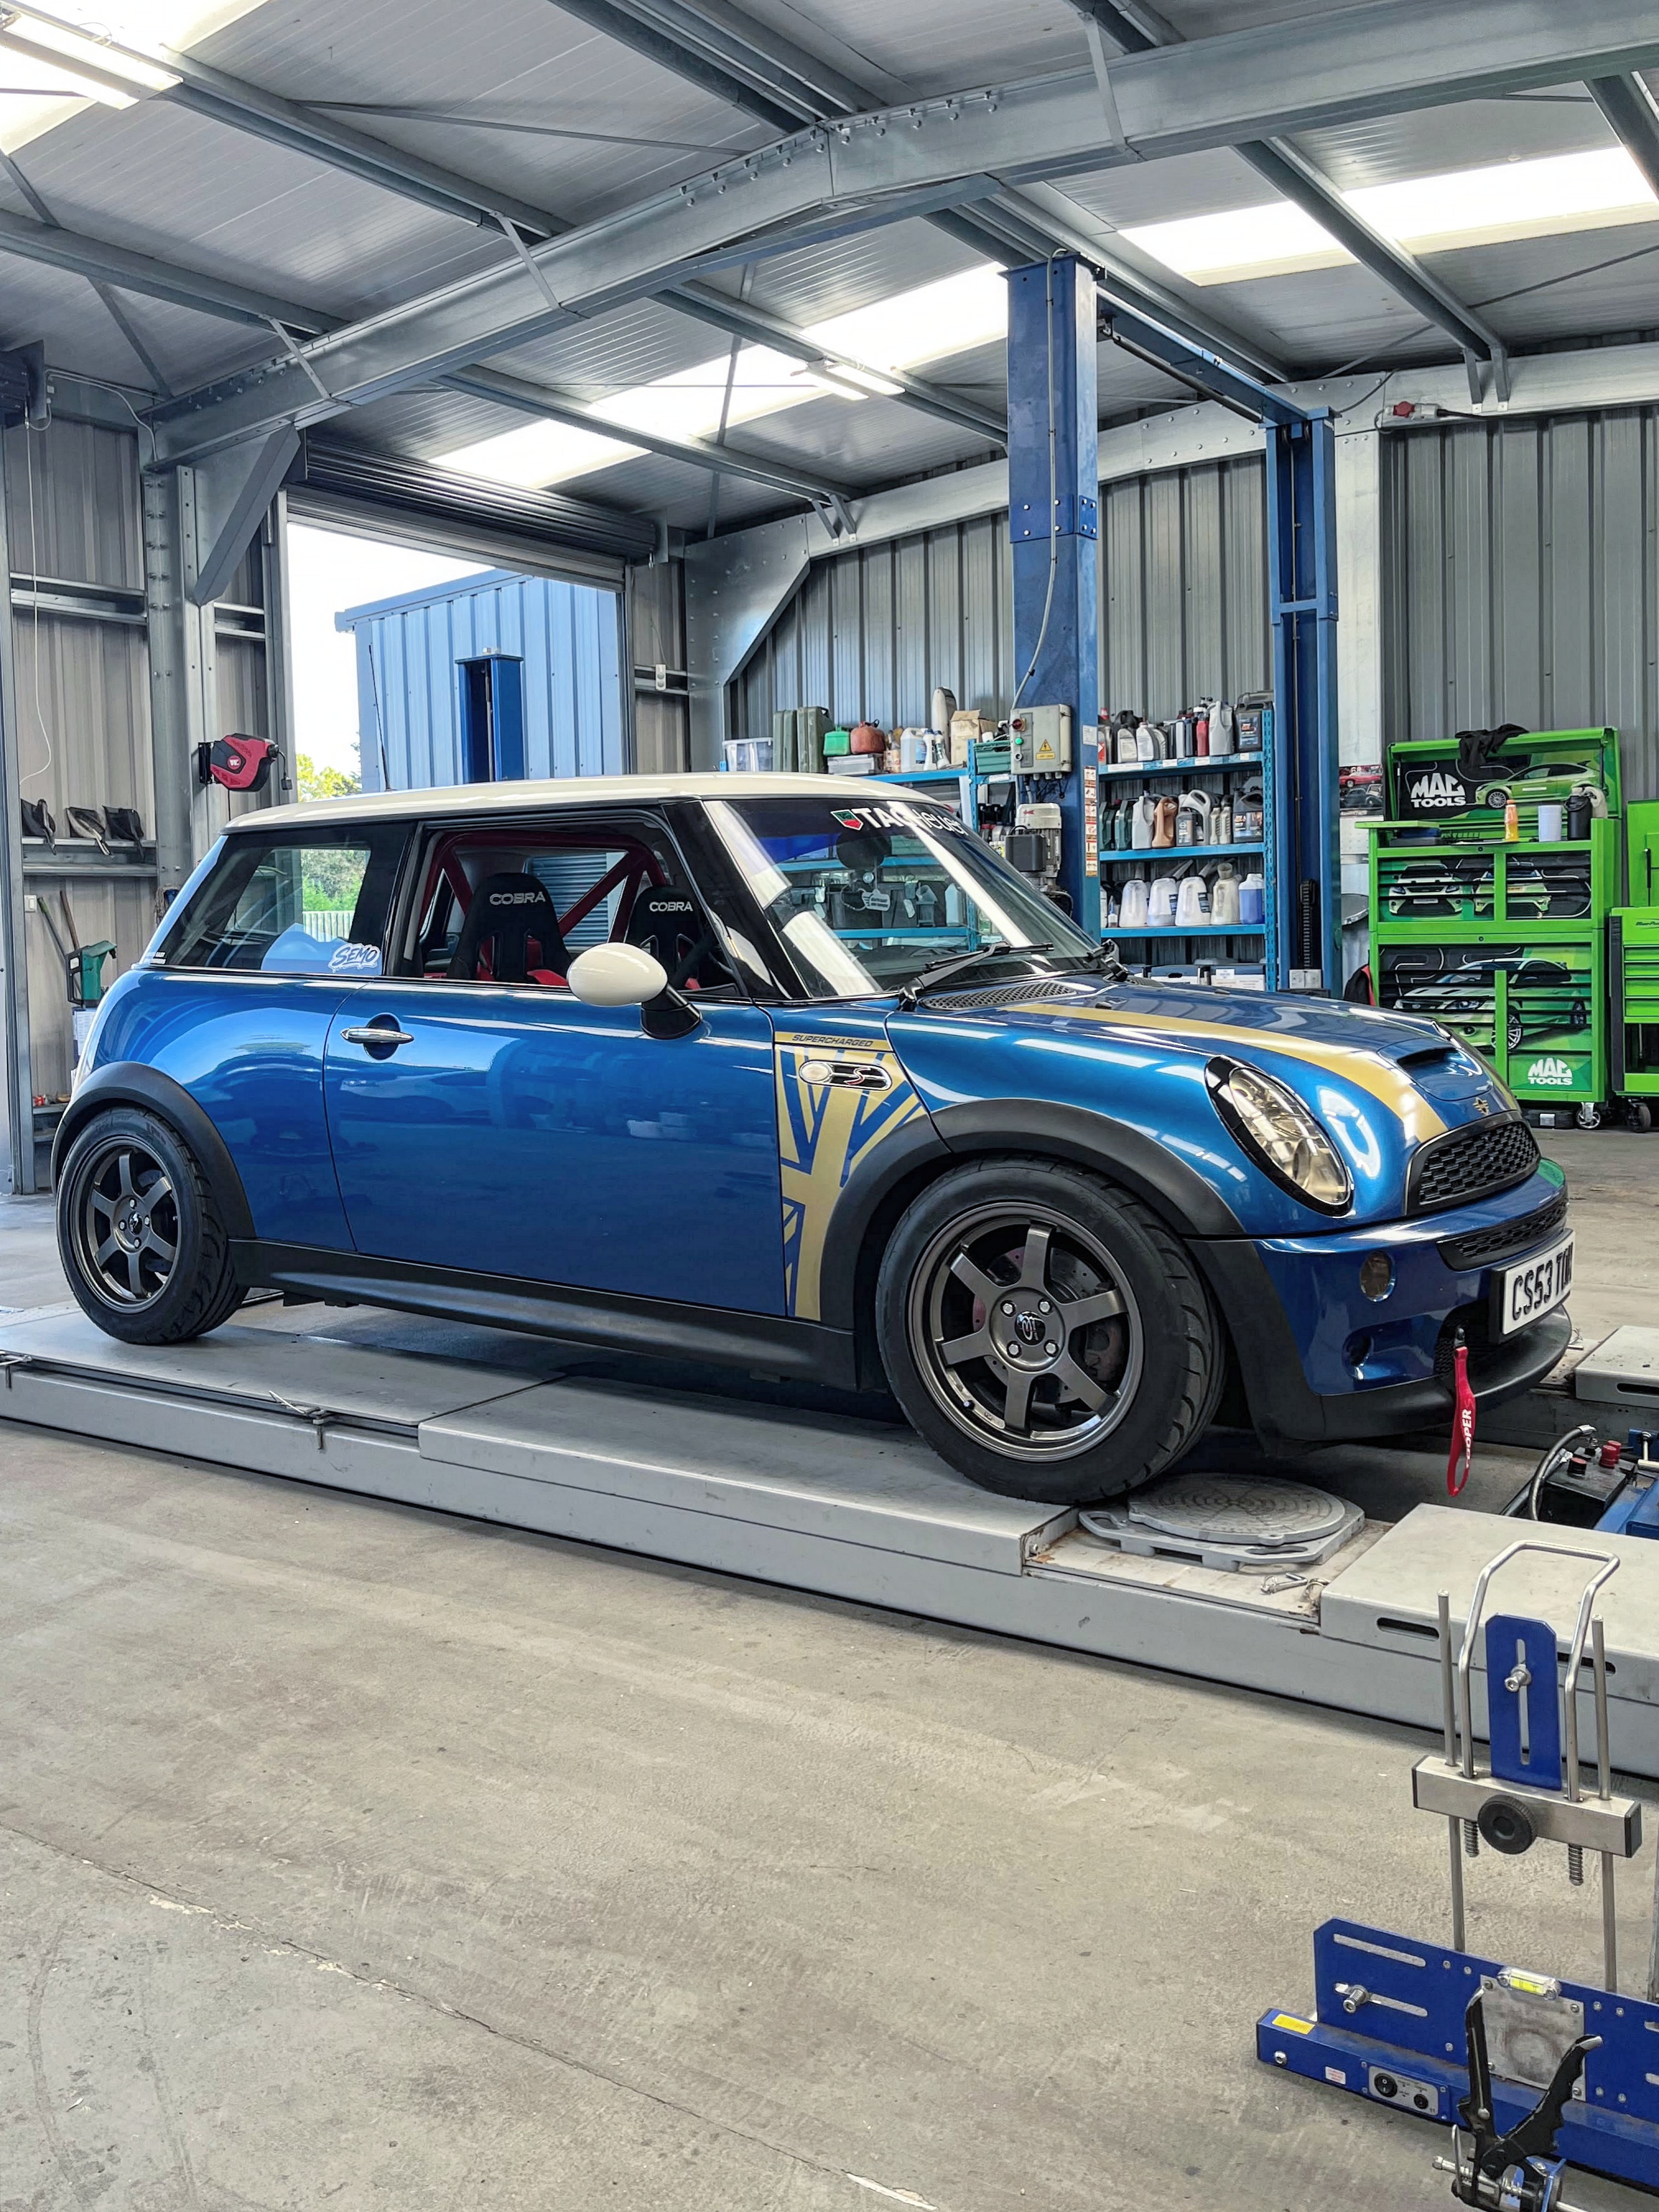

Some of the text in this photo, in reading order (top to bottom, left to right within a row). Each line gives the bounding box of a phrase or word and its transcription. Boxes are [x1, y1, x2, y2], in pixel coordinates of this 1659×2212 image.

[1410, 772, 1465, 798] MAC
[1410, 796, 1466, 808] TOOLS
[489, 891, 546, 905] COBRA
[649, 901, 693, 912] COBRA
[332, 946, 378, 966] SEMO
[792, 1035, 873, 1047] SUPERCHARGED
[1528, 1057, 1572, 1077] MAC
[1528, 1077, 1573, 1085] TOOLS
[1513, 1260, 1553, 1321] CS53
